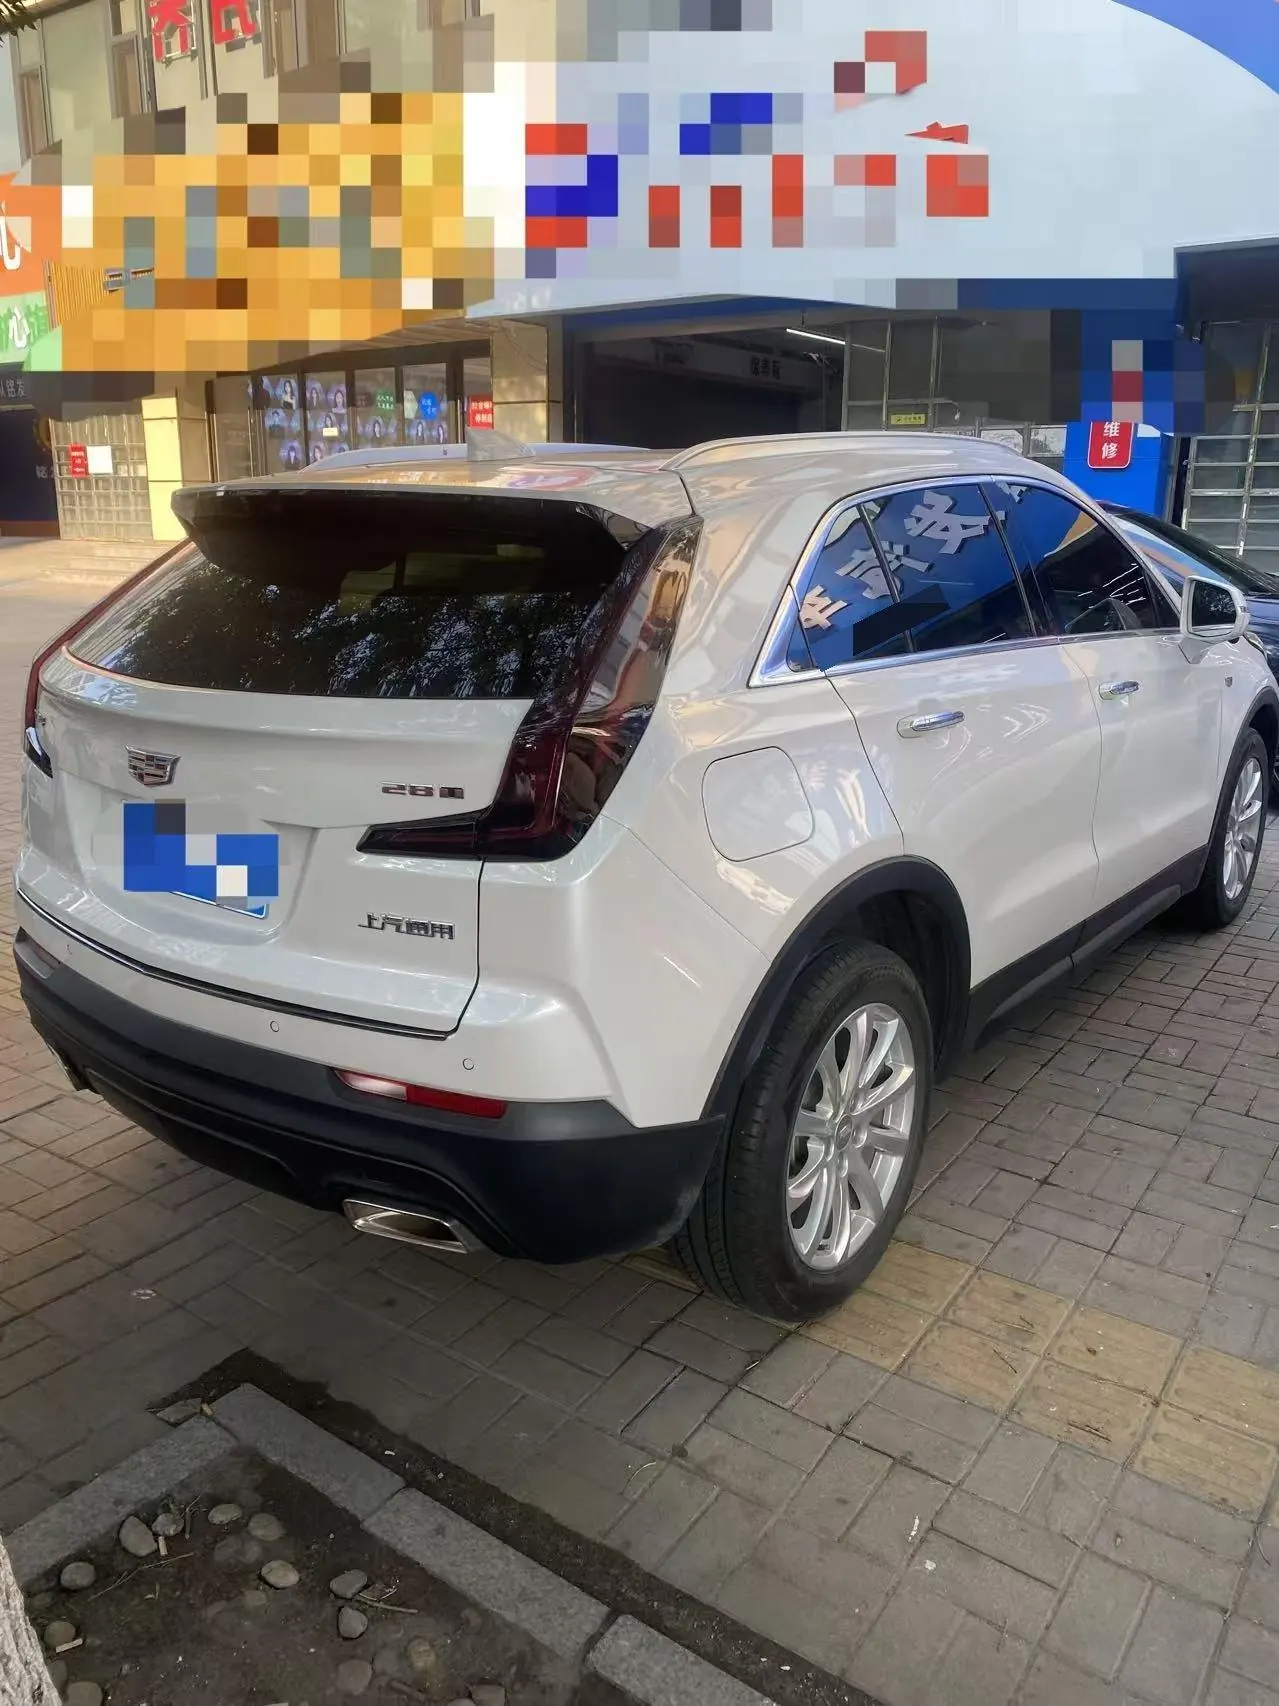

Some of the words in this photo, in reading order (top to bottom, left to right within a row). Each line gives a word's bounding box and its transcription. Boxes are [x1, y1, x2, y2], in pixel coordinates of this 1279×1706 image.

[1102, 421, 1120, 459] 维修
[357, 912, 456, 940] 上汽通用
